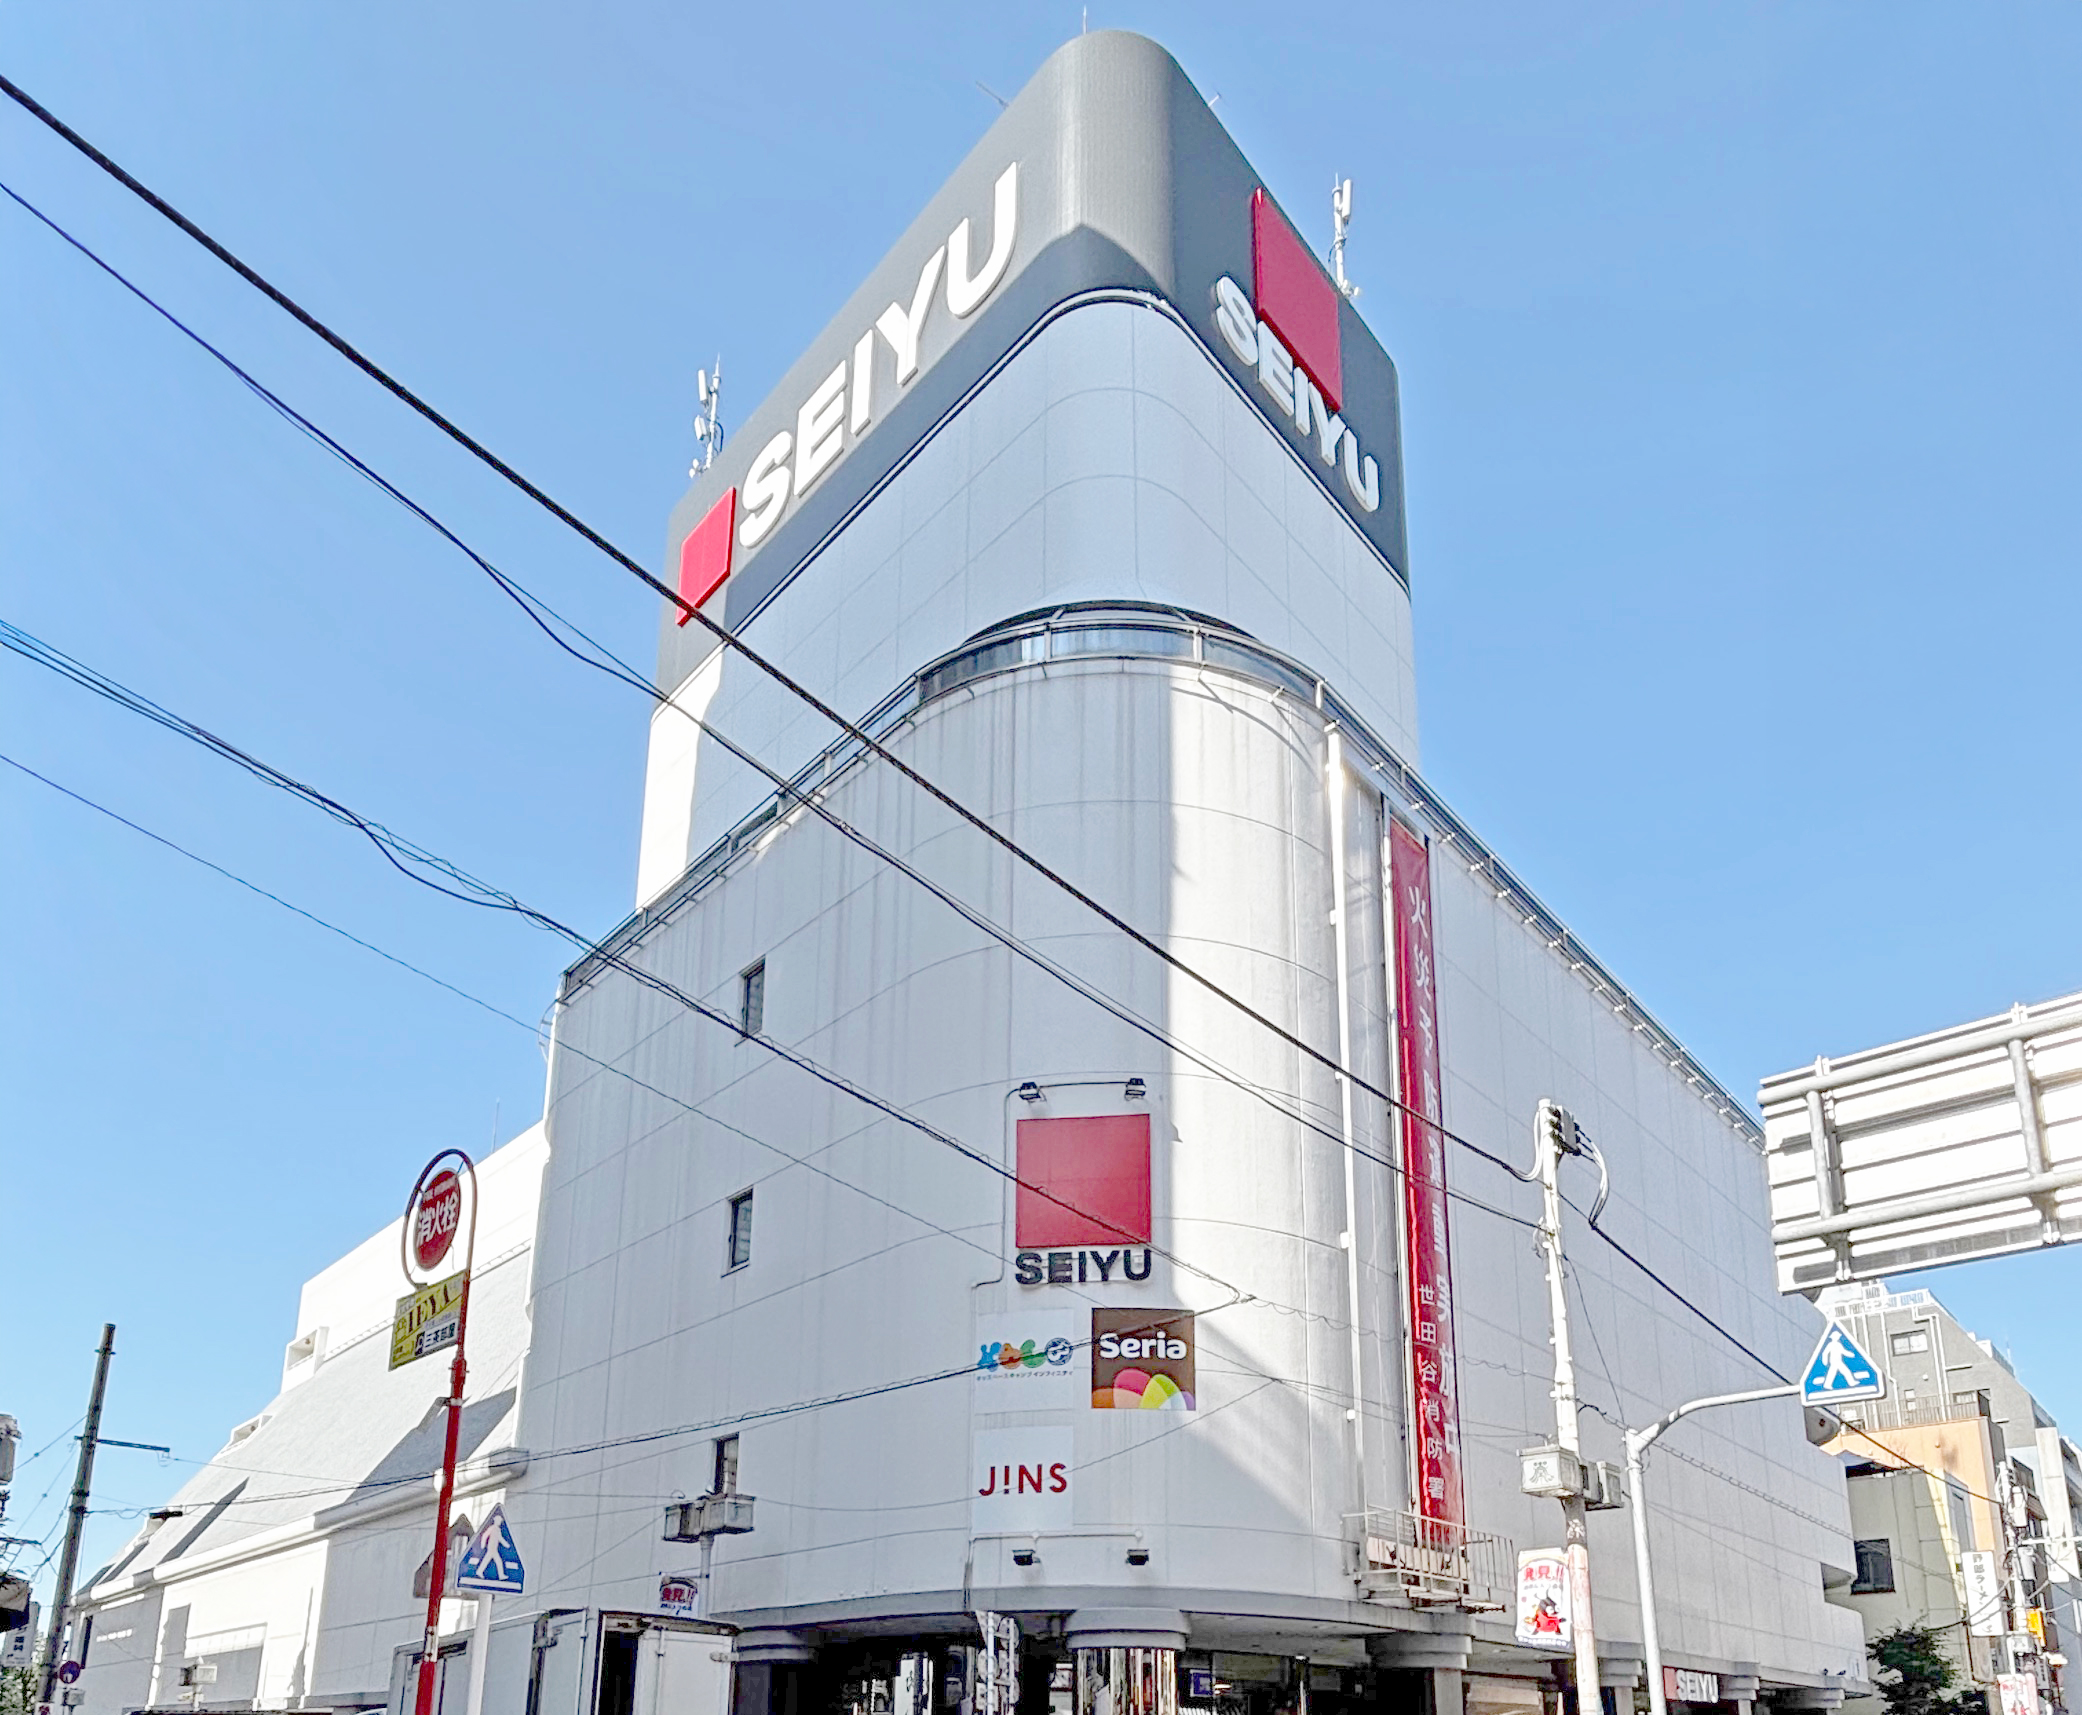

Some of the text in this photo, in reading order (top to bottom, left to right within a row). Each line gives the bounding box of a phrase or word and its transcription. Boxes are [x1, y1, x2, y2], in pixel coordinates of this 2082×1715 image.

[739, 161, 1019, 549] SEIYU
[1214, 275, 1382, 513] SEIYU
[416, 1191, 459, 1248] 消火栓
[1015, 1249, 1152, 1285] SEIYU
[1100, 1331, 1187, 1360] Seria
[1418, 1285, 1446, 1500] 世田谷消防署
[1676, 1669, 1719, 1704] SEIYU
